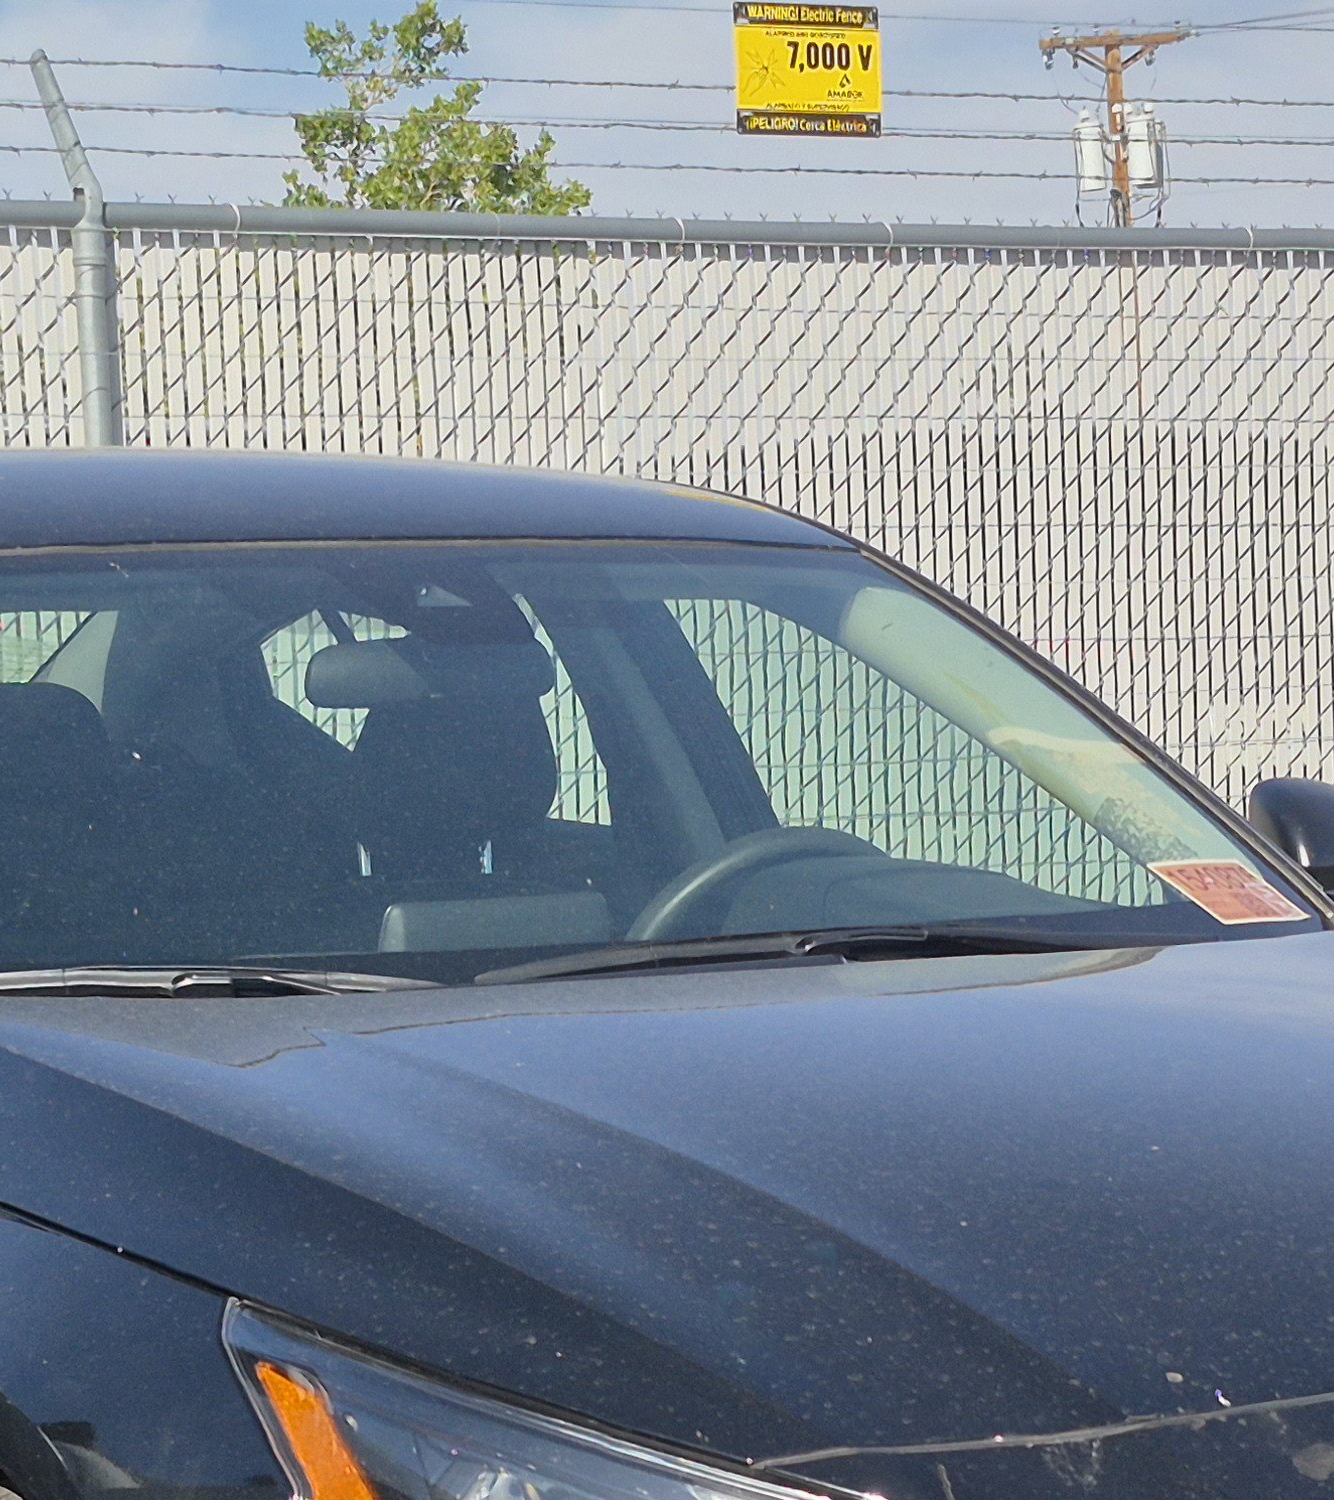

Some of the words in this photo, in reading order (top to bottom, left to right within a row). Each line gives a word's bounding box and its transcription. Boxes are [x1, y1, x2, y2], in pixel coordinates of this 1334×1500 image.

[747, 5, 799, 21] WARNING!
[800, 6, 834, 22] Electric
[835, 9, 864, 24] Fence
[787, 41, 850, 73] 7,000
[858, 44, 873, 71] V
